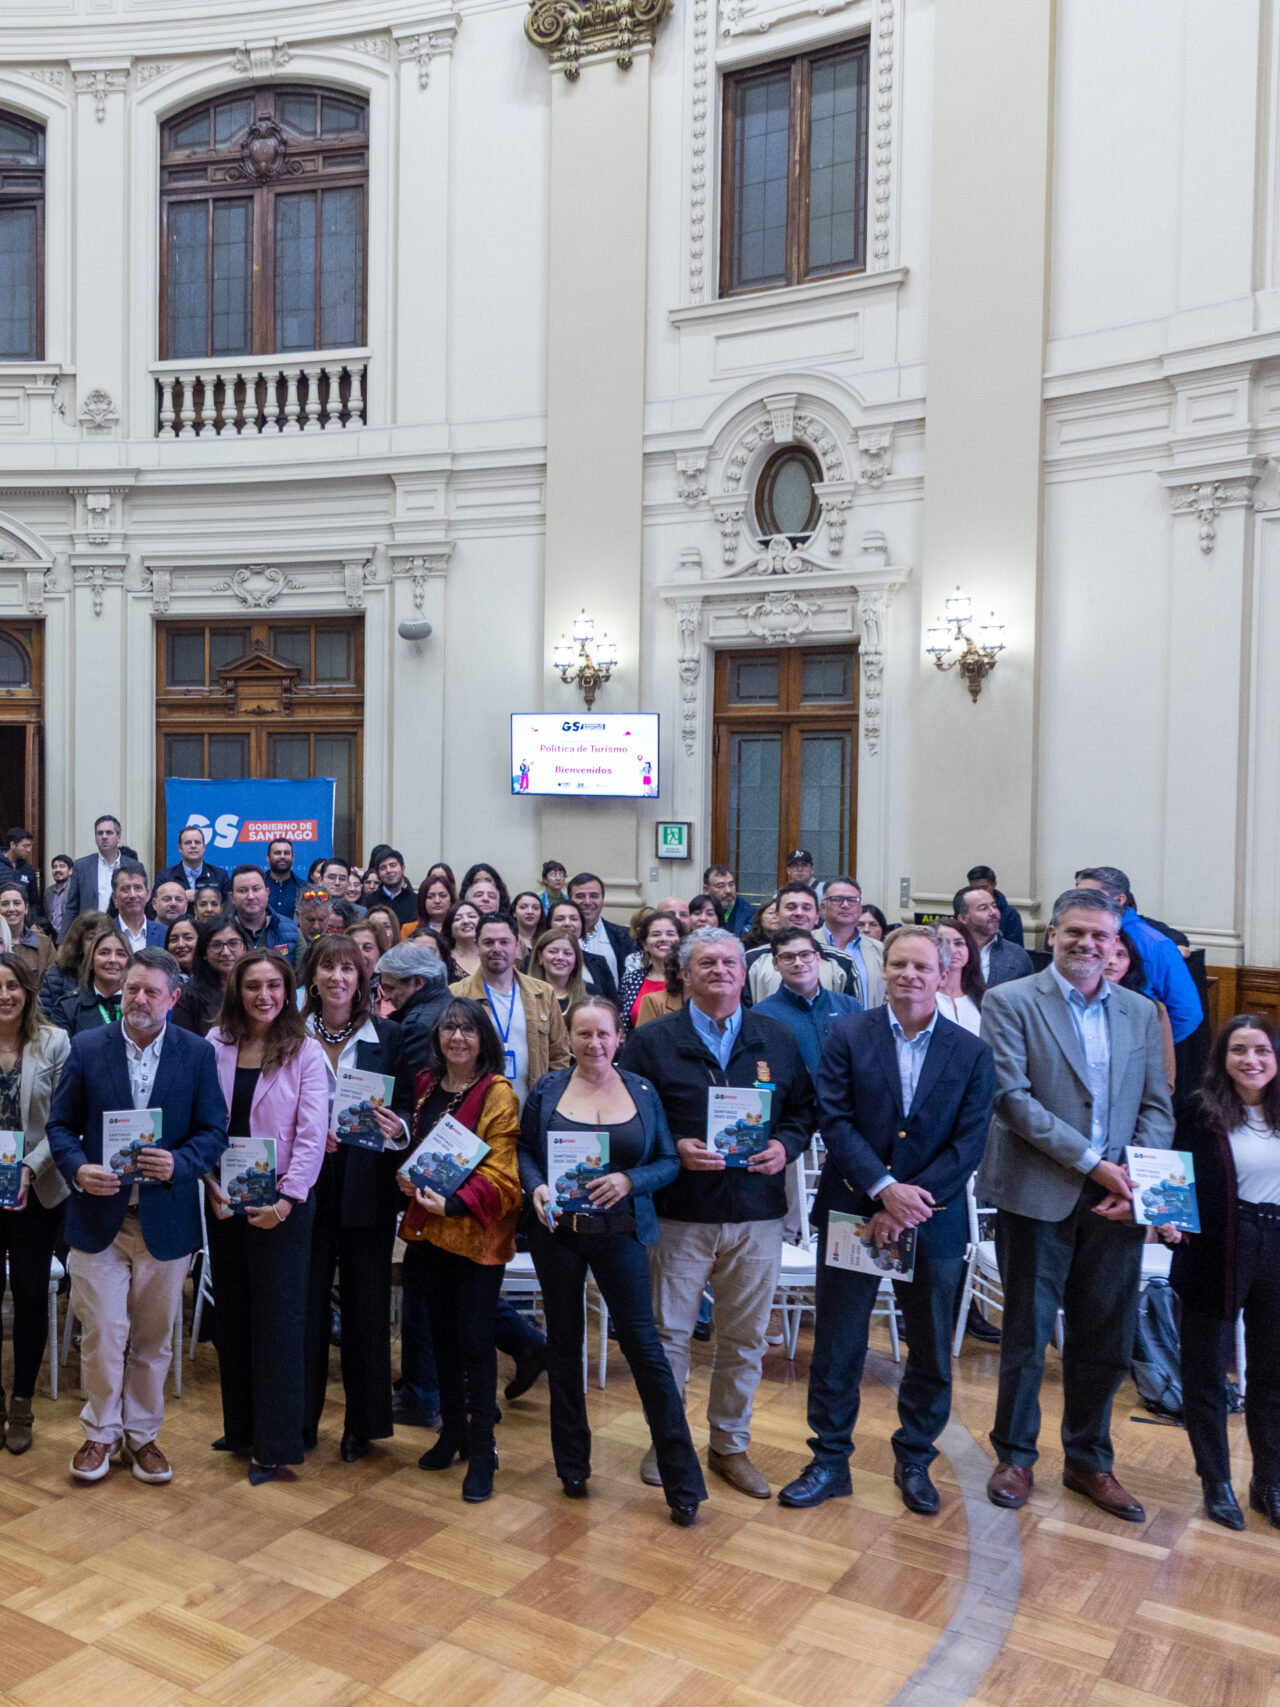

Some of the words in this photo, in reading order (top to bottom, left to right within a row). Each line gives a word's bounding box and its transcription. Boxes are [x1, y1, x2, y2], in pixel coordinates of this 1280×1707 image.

[561, 721, 581, 732] GS
[576, 744, 588, 753] de
[590, 744, 628, 753] Turismo
[554, 765, 613, 775] Bienvenidos
[248, 822, 298, 831] GOBIERNO
[299, 821, 313, 830] DE
[248, 830, 313, 841] SANTIAGO
